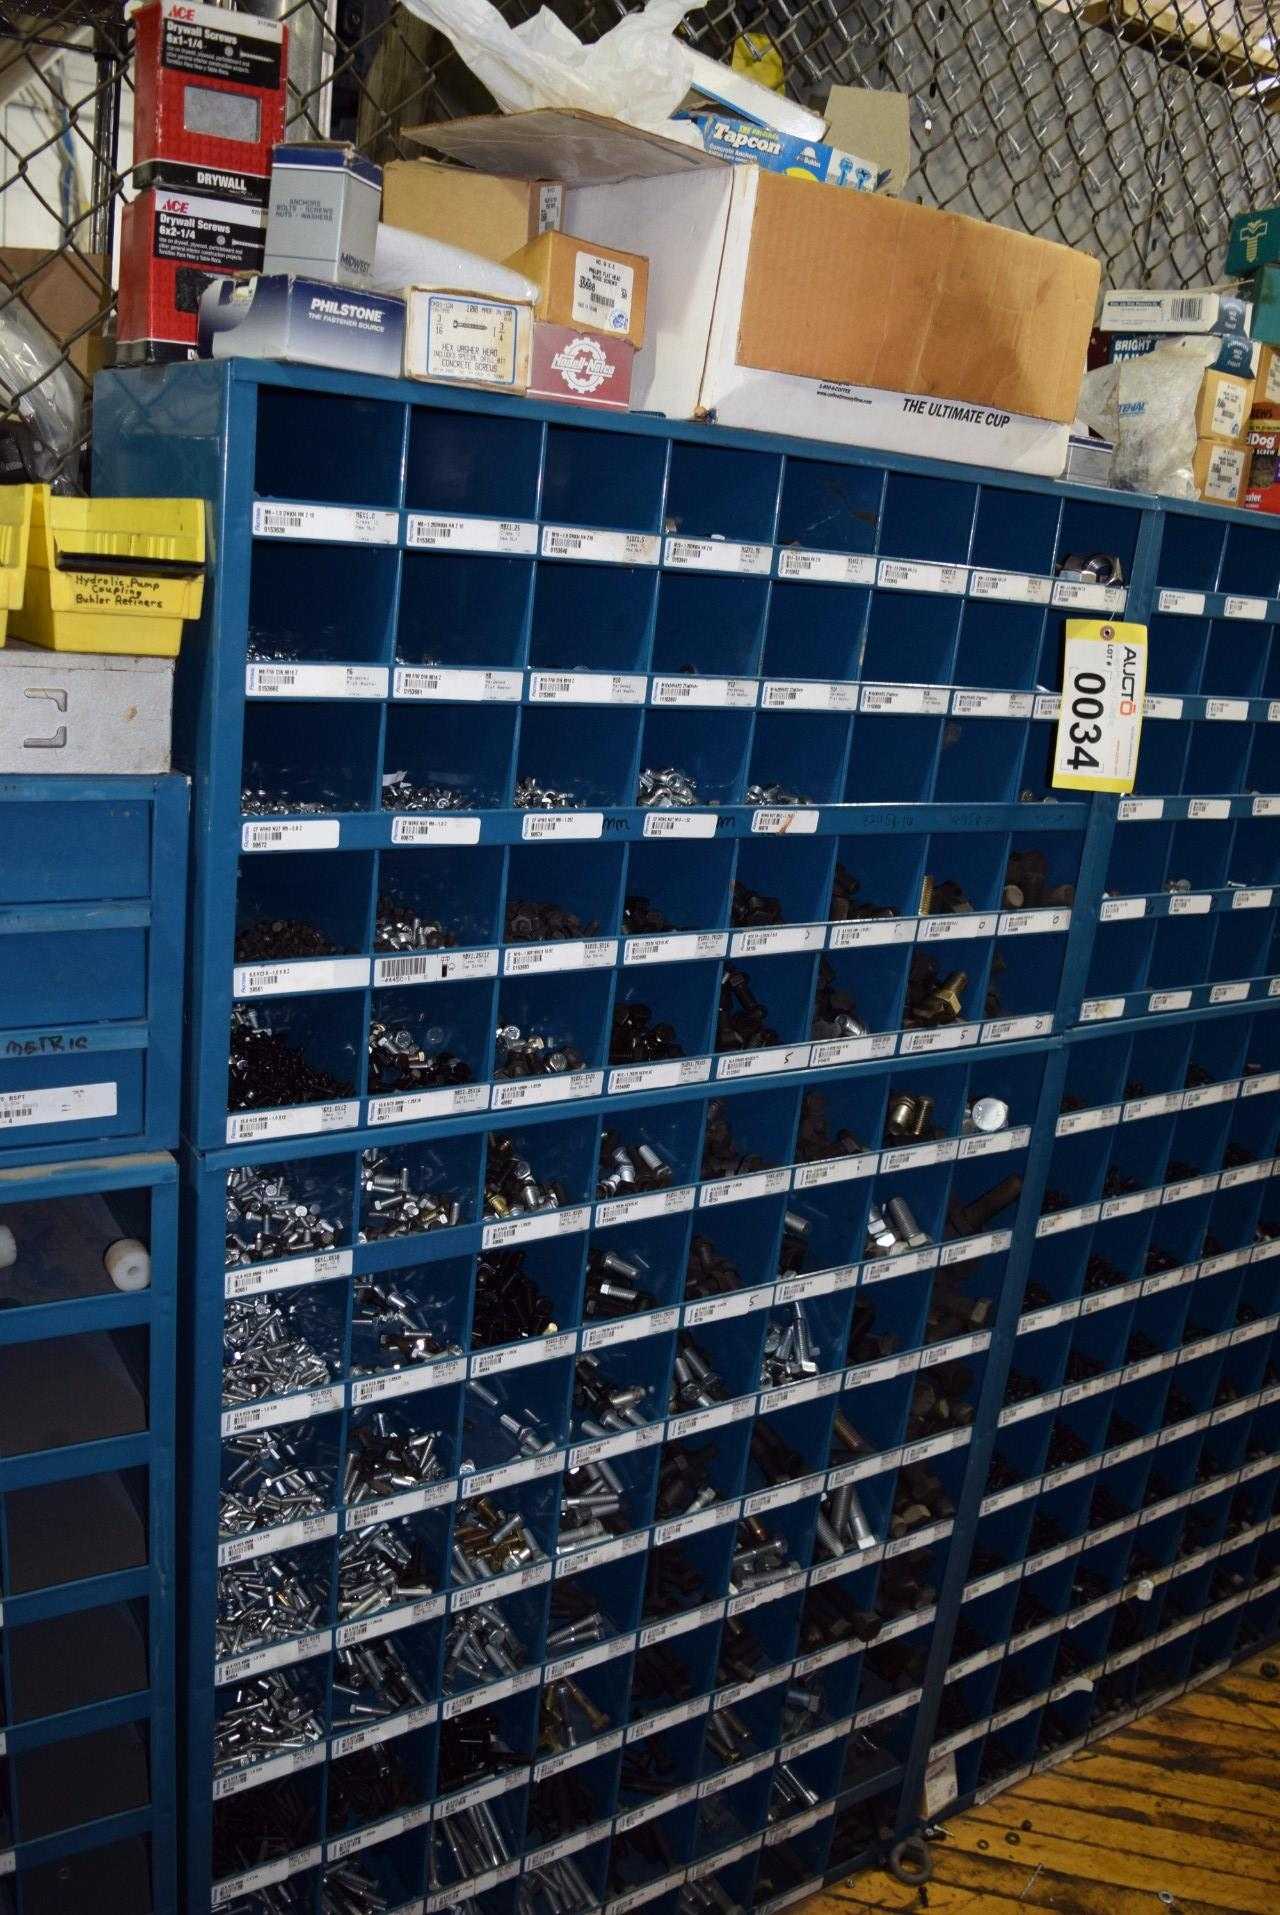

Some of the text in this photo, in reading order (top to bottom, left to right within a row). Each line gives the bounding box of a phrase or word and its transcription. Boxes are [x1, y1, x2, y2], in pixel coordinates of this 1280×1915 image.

[169, 5, 195, 20] ACE
[167, 20, 238, 45] Drywall Screws
[713, 122, 781, 155] Tapcon
[197, 172, 248, 191] DRYWALL
[162, 200, 190, 214] ACE
[159, 225, 196, 239] 6x2-1/4
[160, 213, 231, 234] Drywall Screws
[311, 298, 383, 323] PHILSTONE
[1115, 339, 1152, 351] BRIGHT
[902, 398, 1011, 428] THE ULTIMATE CUP
[91, 585, 142, 599] Coupling
[130, 577, 160, 591] Pump
[115, 595, 162, 608] Refiners
[1106, 643, 1114, 660] LOT
[1066, 672, 1106, 770] 0034
